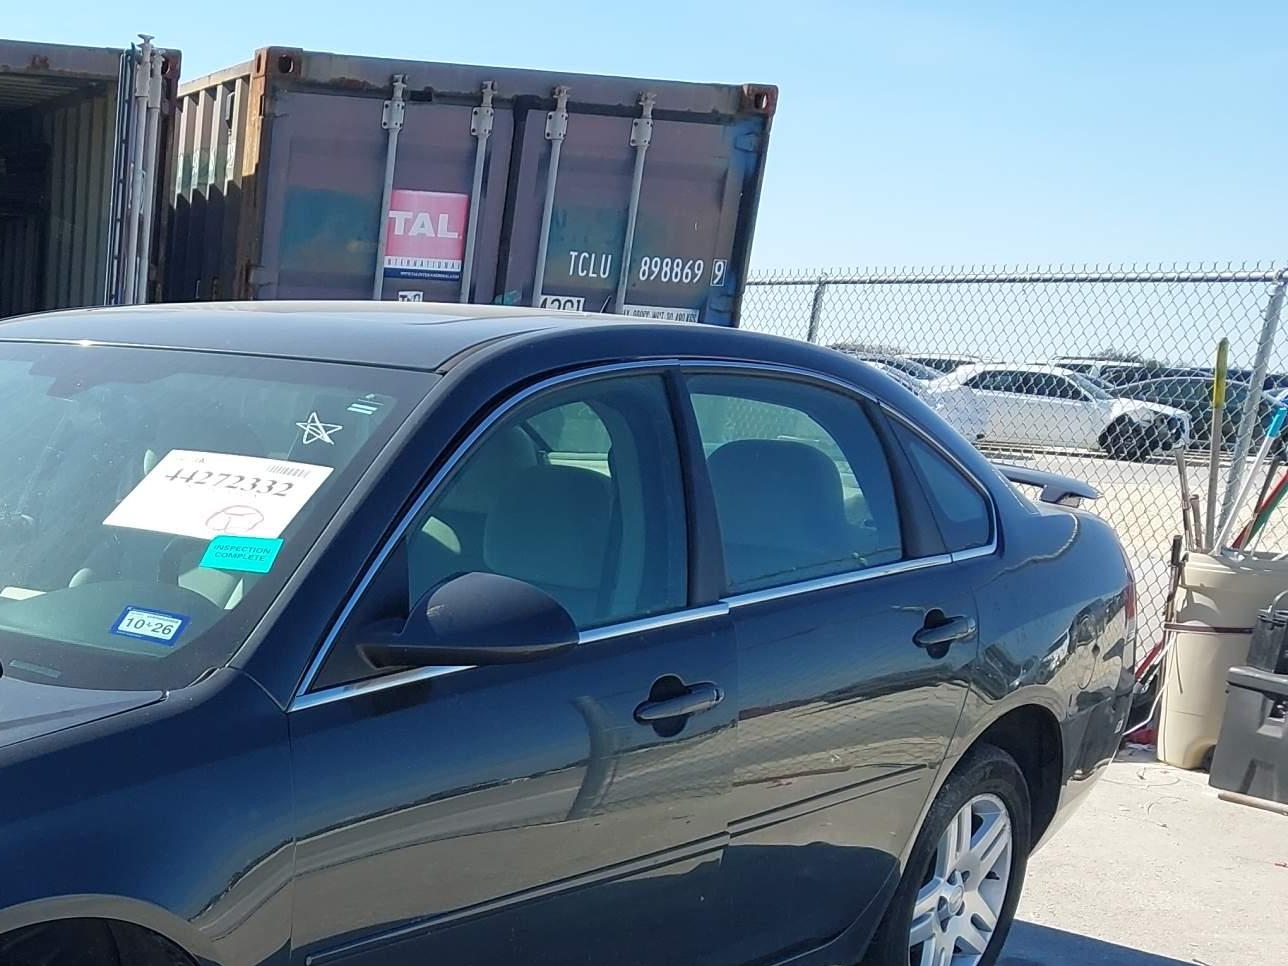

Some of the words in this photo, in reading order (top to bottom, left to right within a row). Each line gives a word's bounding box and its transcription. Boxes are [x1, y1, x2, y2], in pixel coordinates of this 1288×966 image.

[389, 210, 458, 239] TAL
[568, 251, 611, 279] TCLU
[638, 256, 703, 284] 898869
[712, 260, 724, 284] 9
[165, 468, 294, 497] 44272332
[213, 543, 271, 555] INSPECTION
[214, 551, 266, 562] COMPLETE
